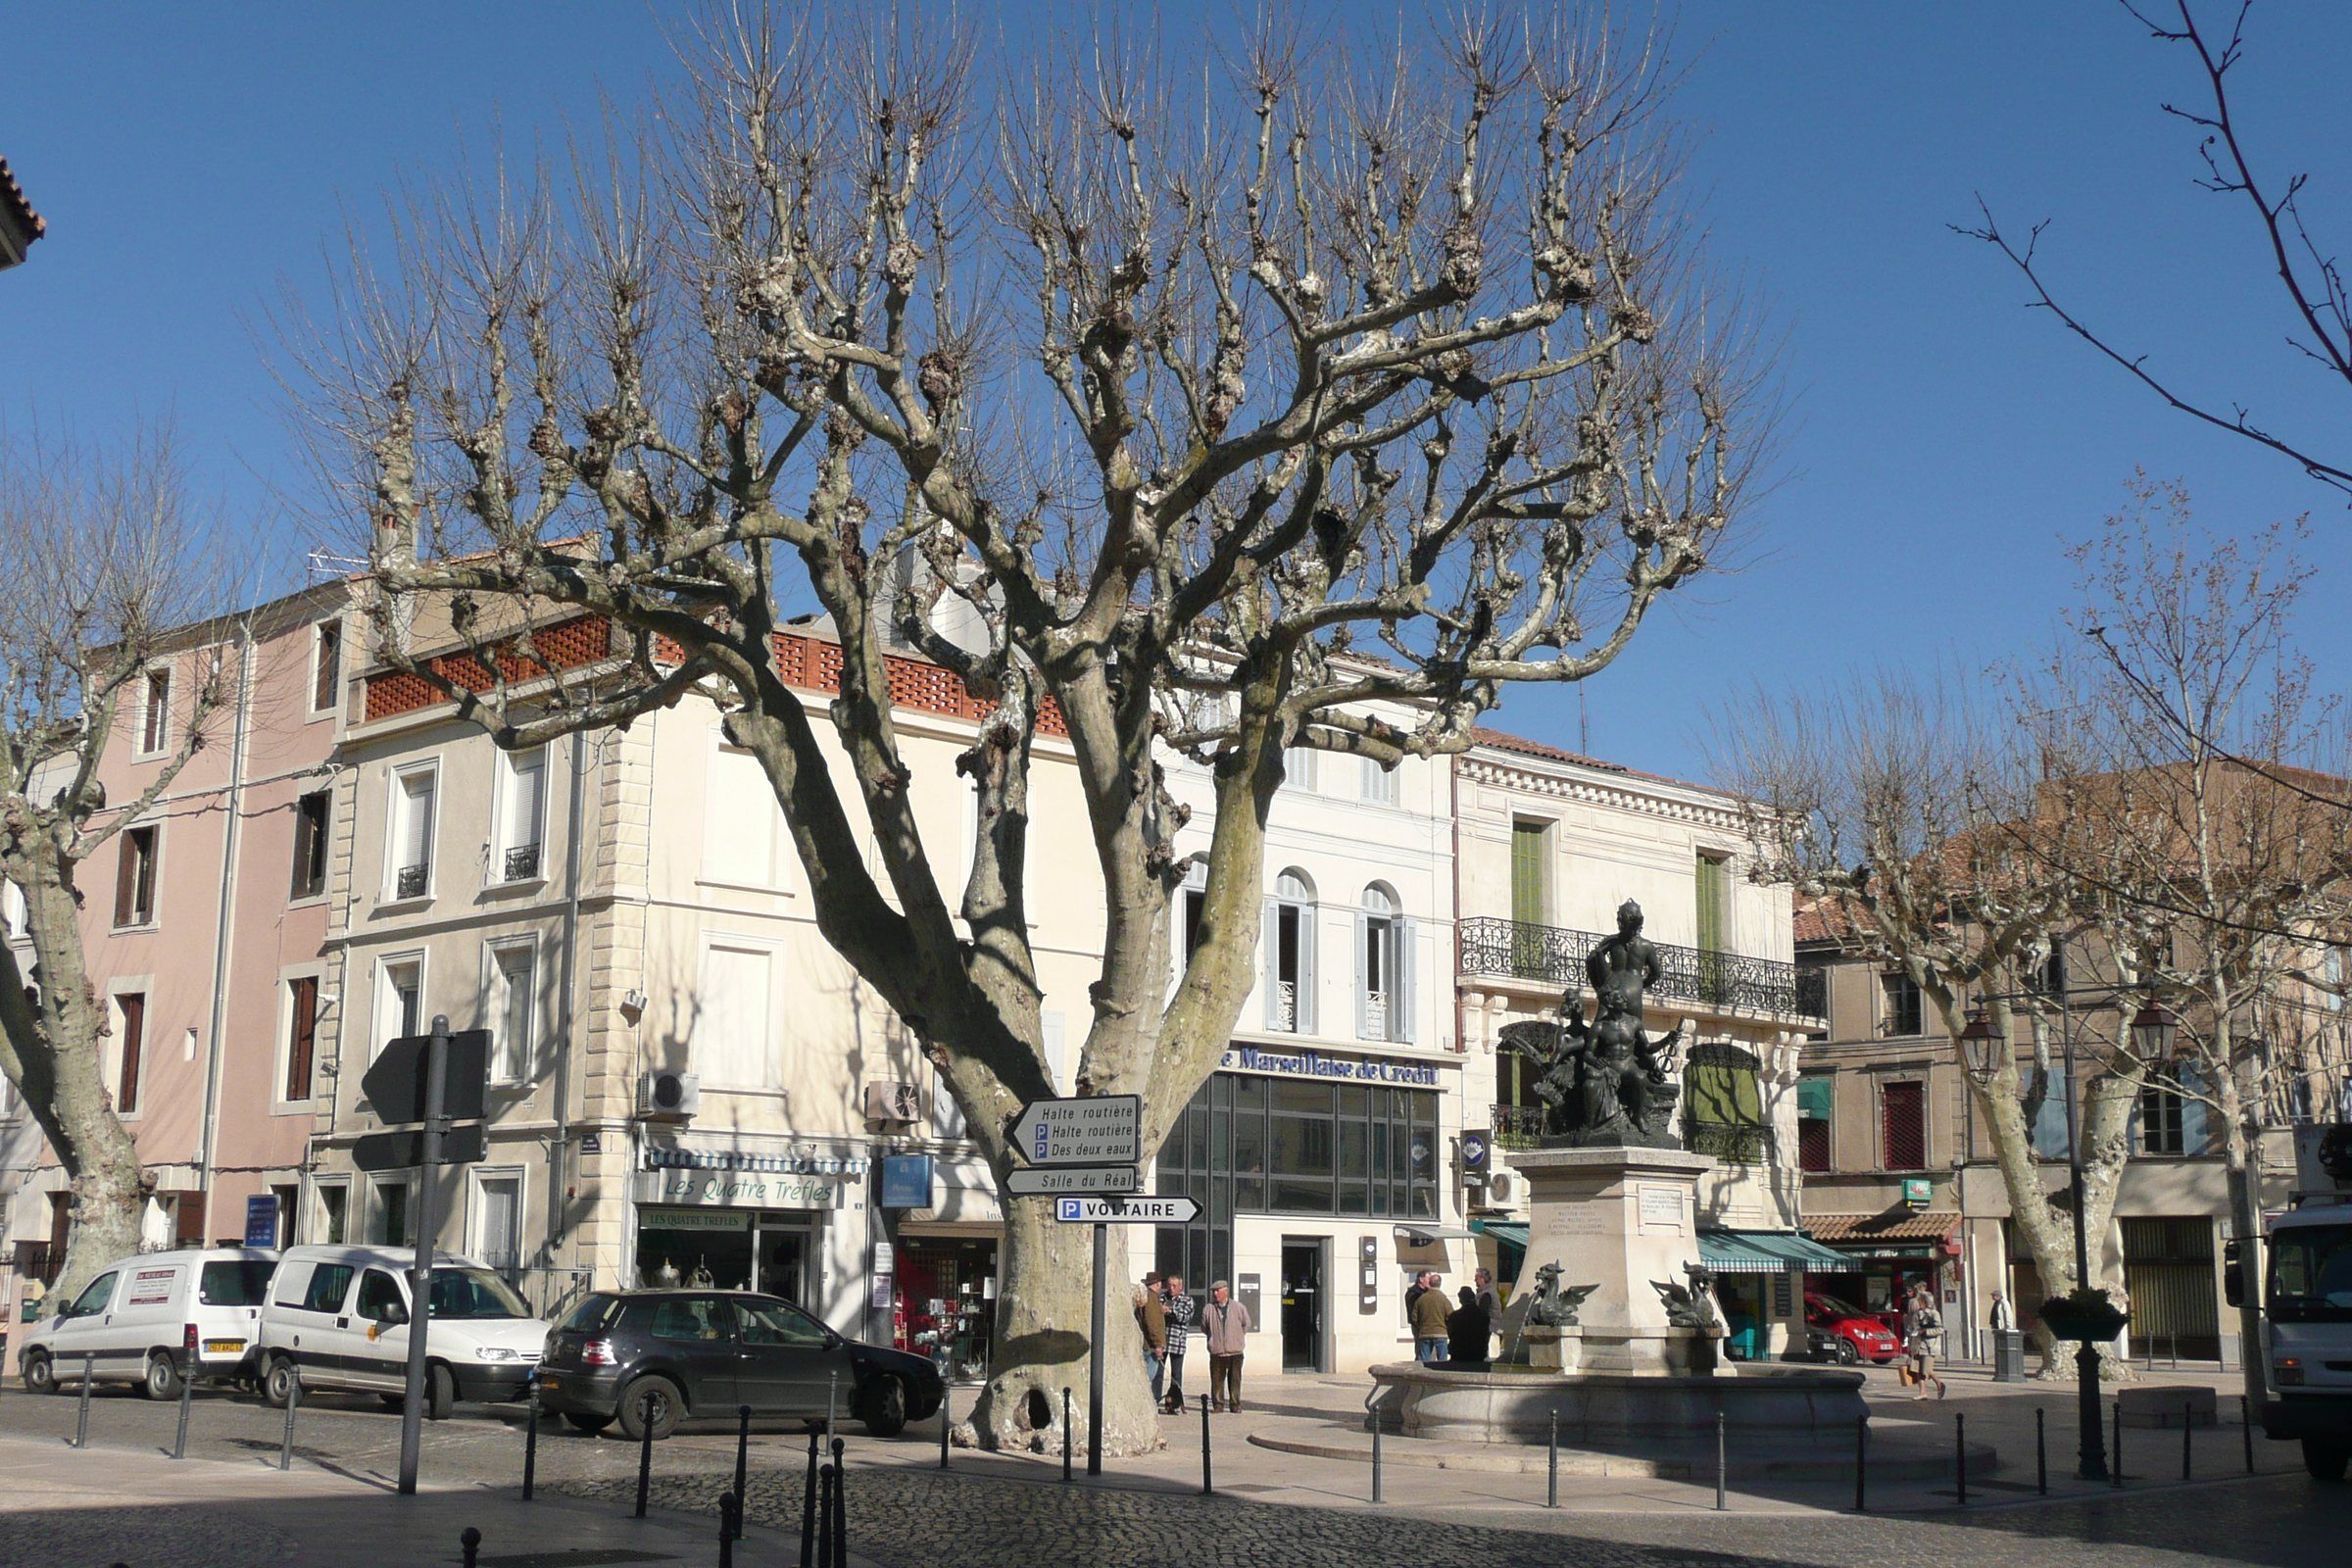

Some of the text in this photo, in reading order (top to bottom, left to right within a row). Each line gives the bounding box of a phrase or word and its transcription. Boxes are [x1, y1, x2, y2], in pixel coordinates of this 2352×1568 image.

[1239, 1047, 1354, 1078] Marseillaise
[1355, 1059, 1378, 1079] de
[1380, 1060, 1439, 1085] Crédit
[1042, 1105, 1133, 1120] Halte routière
[1037, 1124, 1133, 1139] P Halte routière
[1037, 1143, 1132, 1157] P Des deux eaux
[1041, 1173, 1132, 1188] Salle du Réal
[665, 1177, 832, 1201] Les Quatre Trèfles
[1065, 1202, 1175, 1217] P VOLTAIRE
[650, 1214, 666, 1224] LES
[667, 1214, 701, 1225] QUATRE
